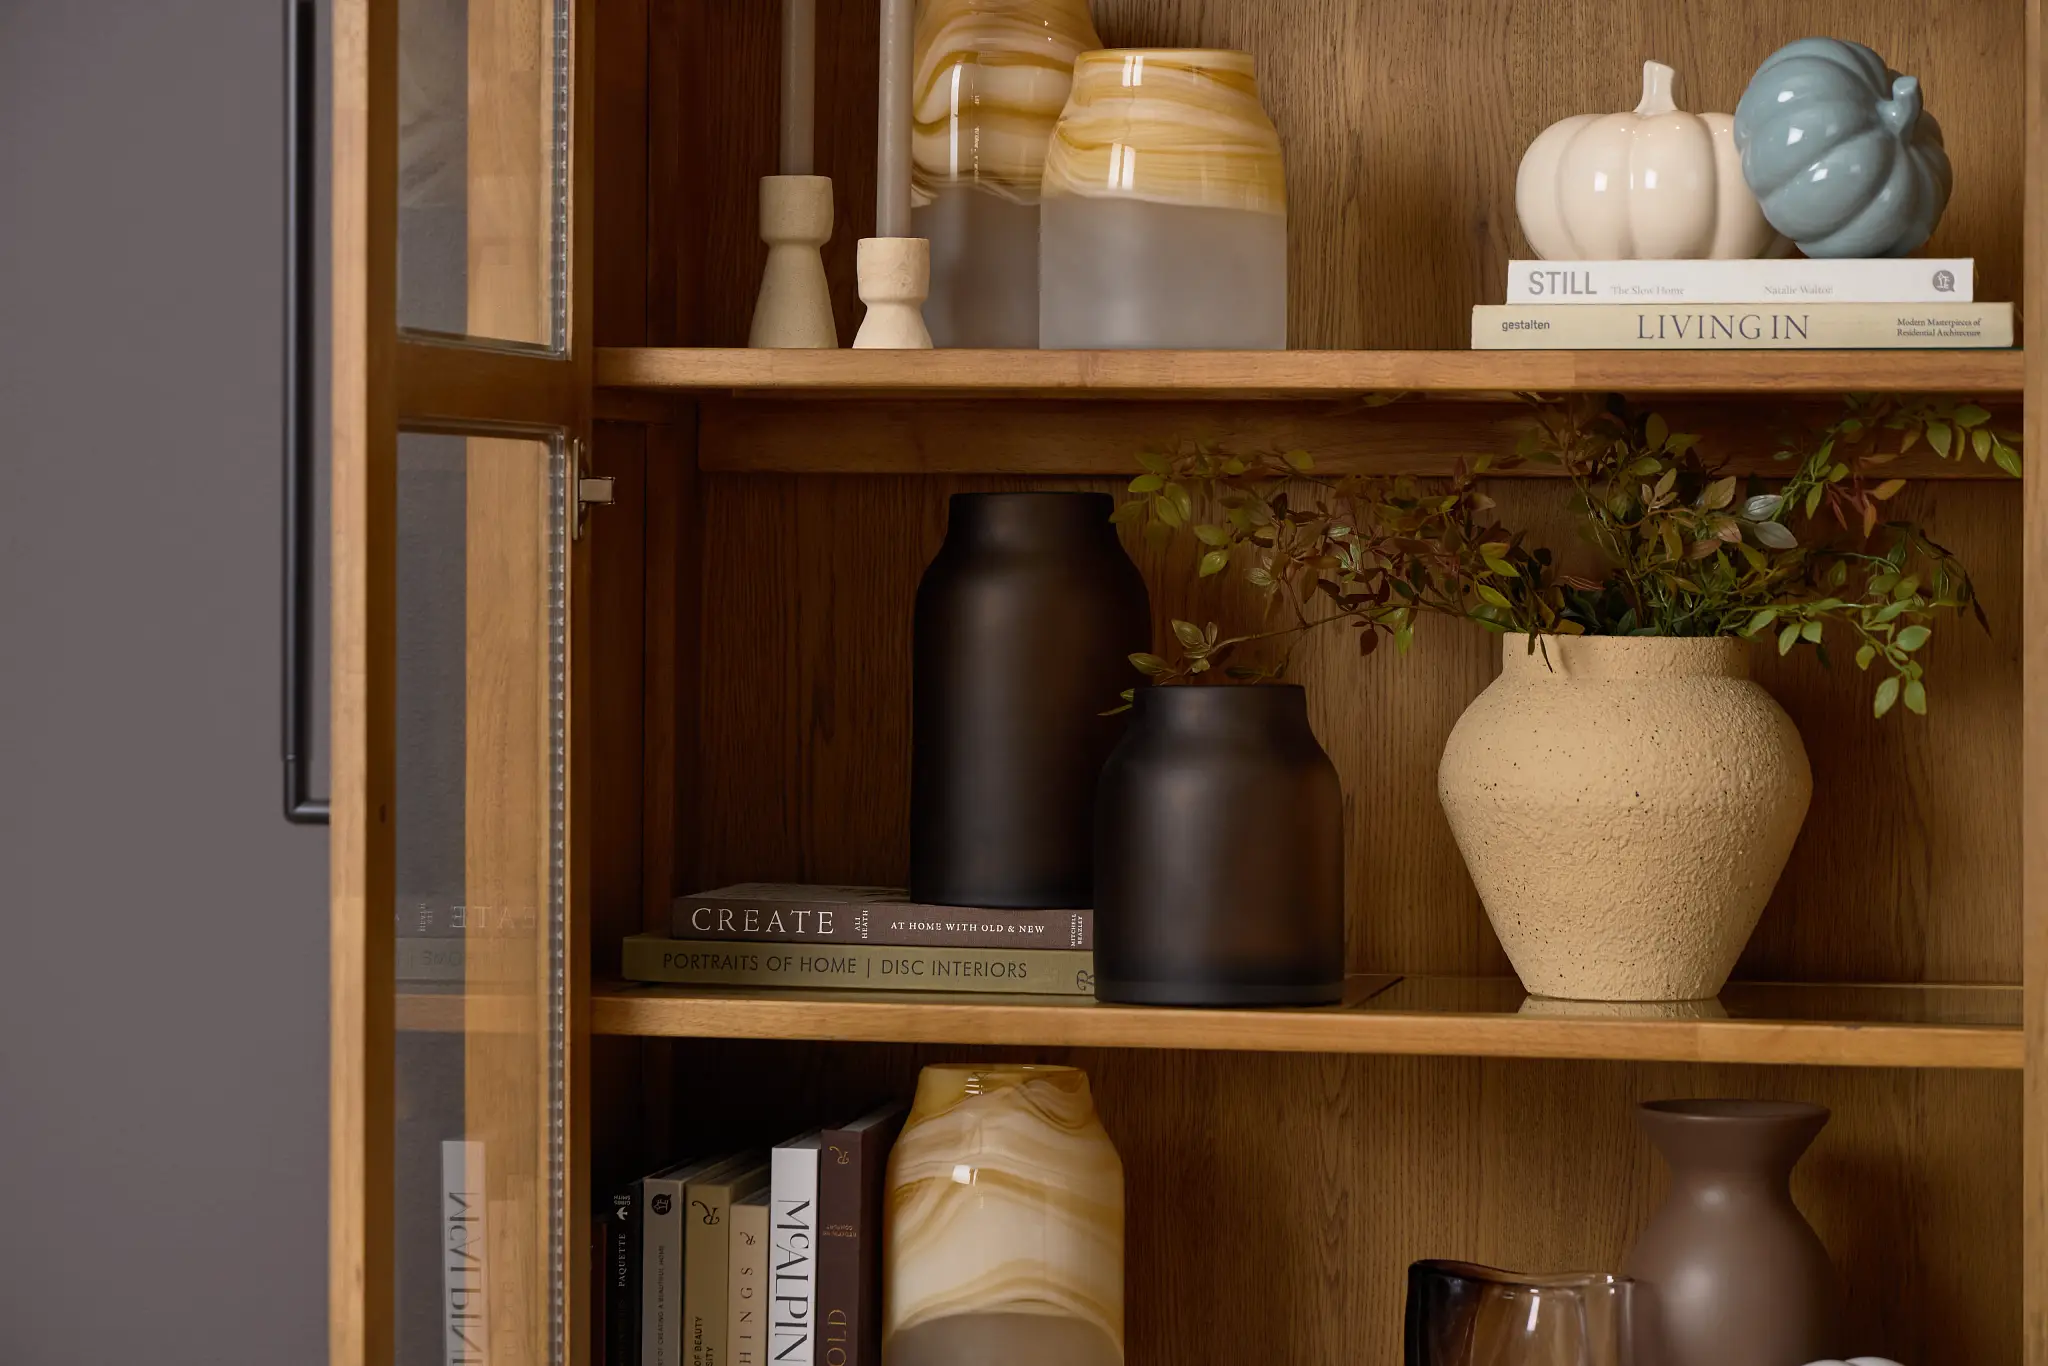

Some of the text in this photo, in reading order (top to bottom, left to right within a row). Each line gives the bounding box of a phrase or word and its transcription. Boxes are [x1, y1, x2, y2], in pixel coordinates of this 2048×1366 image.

[1528, 271, 1685, 296] STILL The Slow Home
[1763, 285, 1834, 296] Natalie Walton
[1501, 318, 1550, 332] gestalten
[1637, 314, 1810, 340] LIVING IN
[1897, 317, 1982, 328] Modern Masterpieces of
[1897, 328, 1981, 337] Residential Architecture
[691, 907, 834, 934] CREATE
[890, 921, 1045, 933] AT HOME WITH OLD & NEW
[662, 953, 759, 971] PORTRAITS
[766, 956, 793, 972] OF
[800, 957, 857, 974] HOME
[881, 958, 925, 976] DISC
[931, 960, 1028, 979] INTERIORS
[618, 1233, 627, 1287] PAQUETTE
[694, 1316, 703, 1352] BEAUTY
